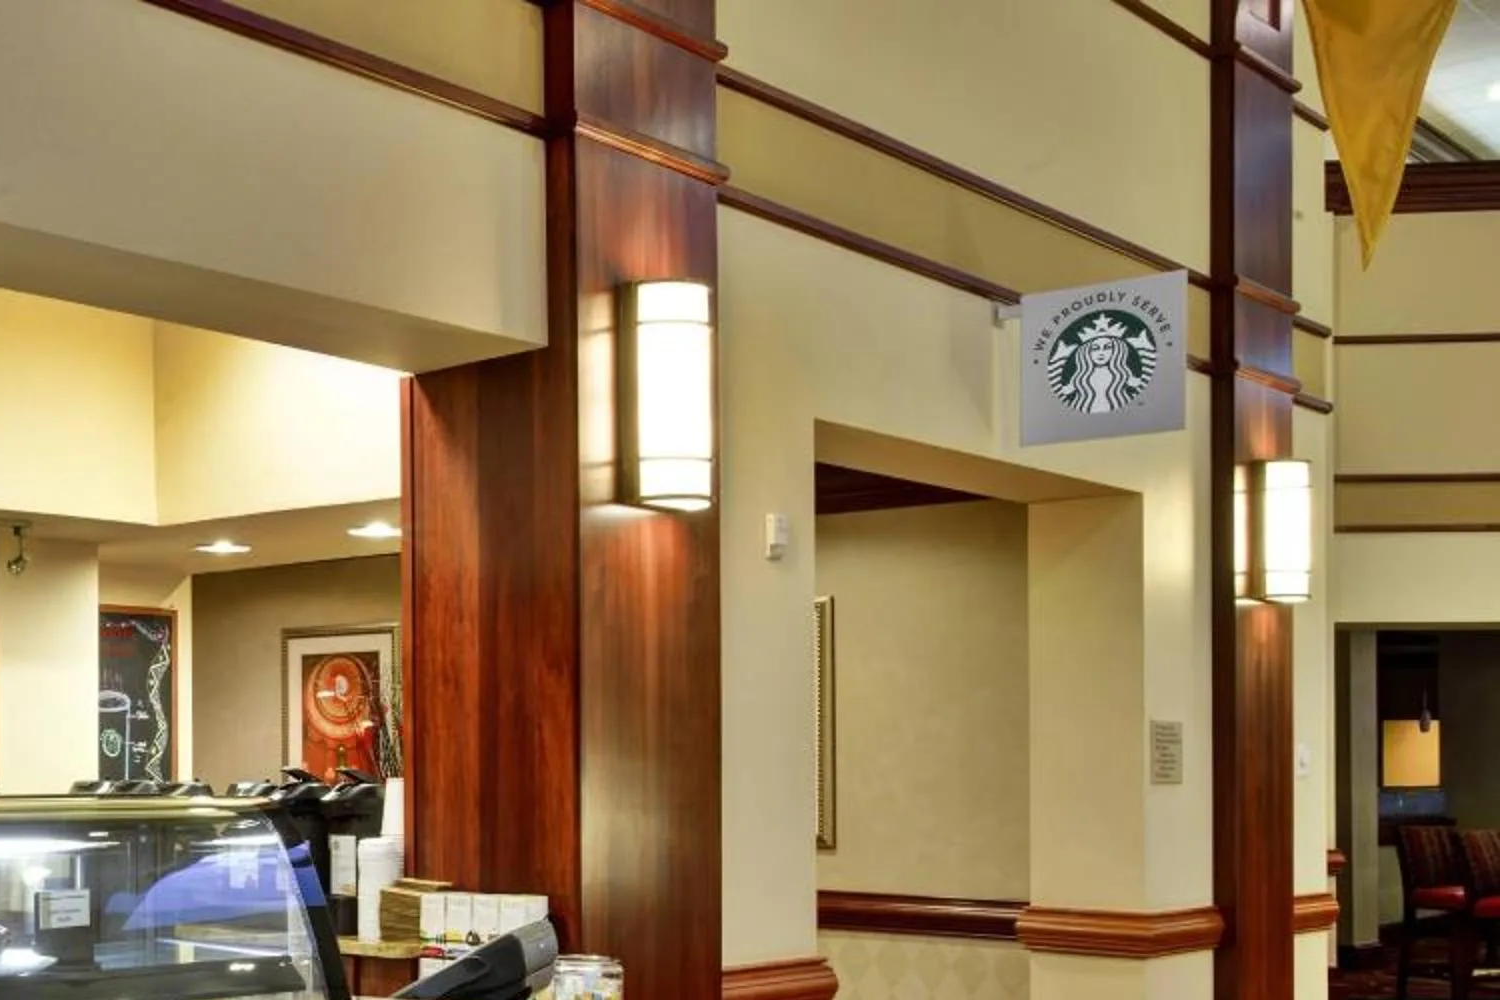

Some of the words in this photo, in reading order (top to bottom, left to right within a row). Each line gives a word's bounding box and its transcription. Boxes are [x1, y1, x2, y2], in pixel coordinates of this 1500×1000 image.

[1033, 331, 1051, 353] WE
[1053, 290, 1128, 326] PROUDLY
[1132, 294, 1172, 334] SERVE
